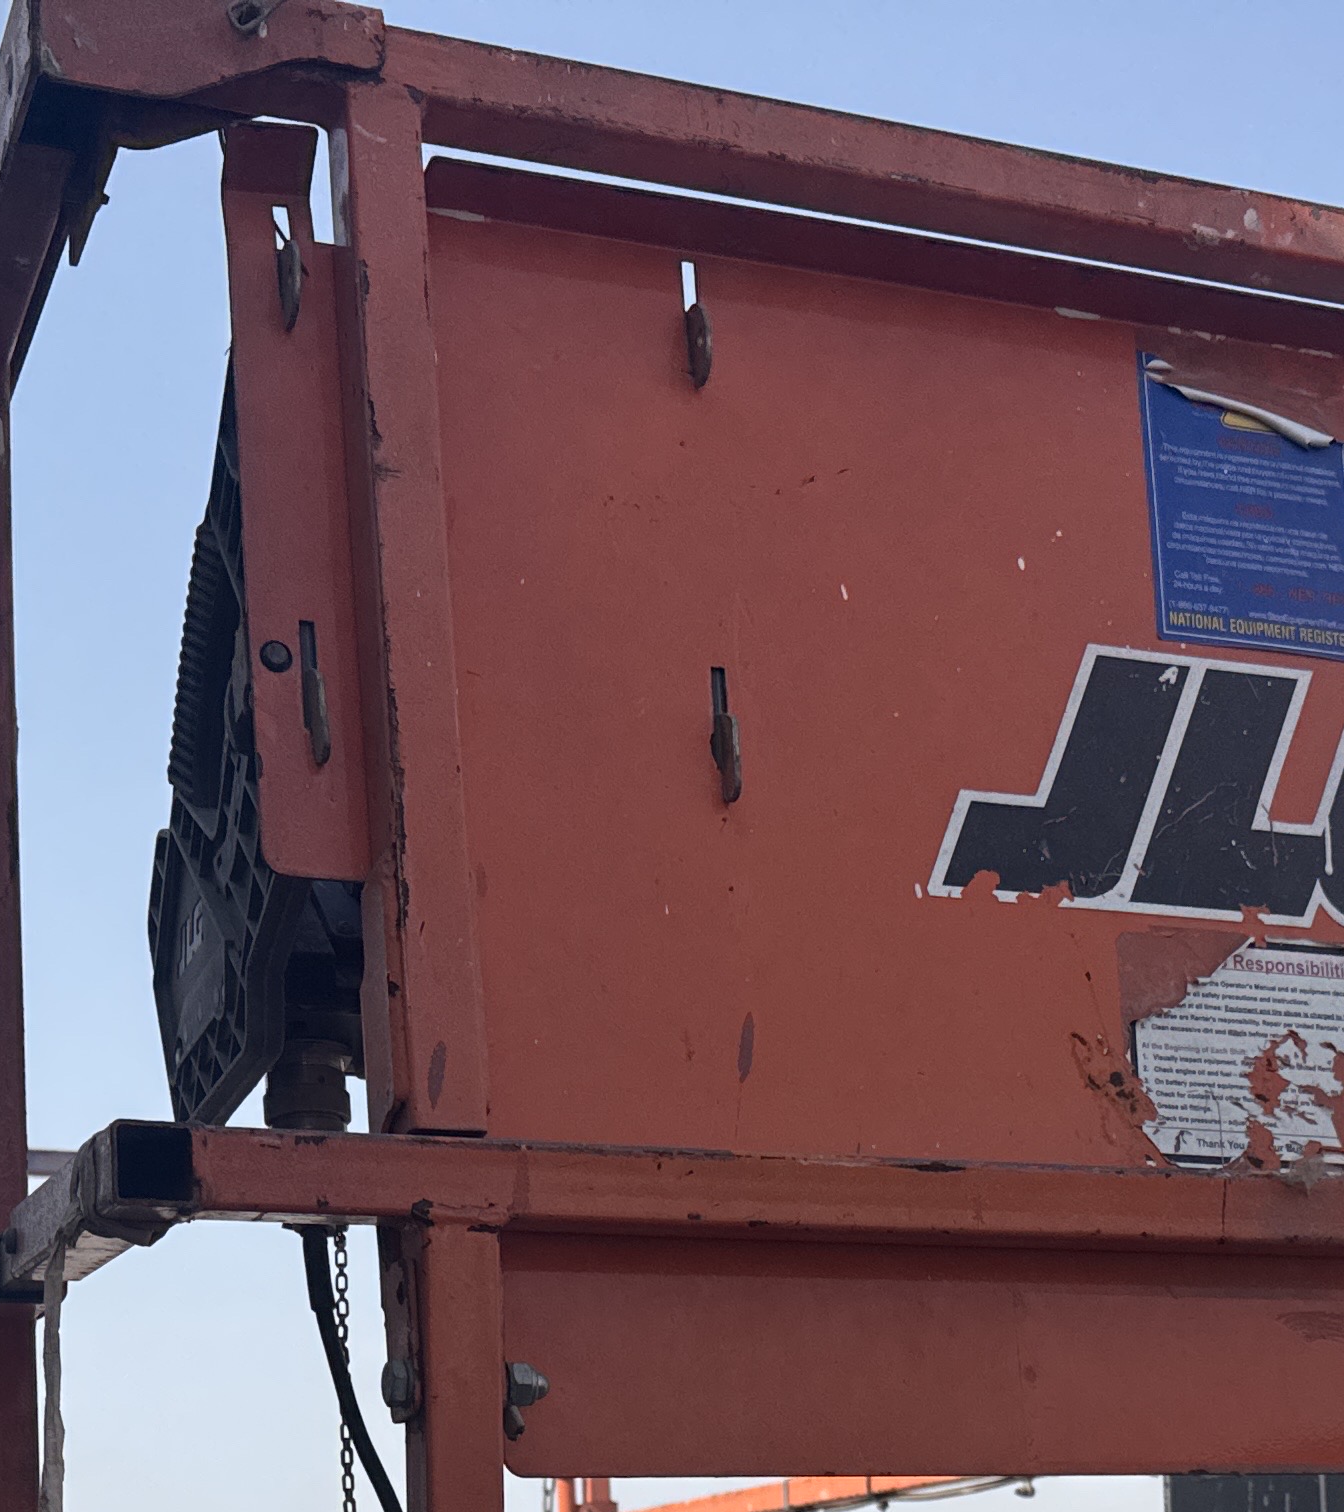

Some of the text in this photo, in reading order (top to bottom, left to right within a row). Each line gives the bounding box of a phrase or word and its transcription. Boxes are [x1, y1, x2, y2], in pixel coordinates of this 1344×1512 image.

[1169, 611, 1226, 632] NATIONAL
[1230, 618, 1296, 641] EQUIPMENT
[1220, 981, 1253, 989] Operator's
[1151, 1023, 1169, 1031] Clean
[1164, 1042, 1200, 1054] Beginning
[1153, 1053, 1178, 1063] Visually
[1179, 1055, 1202, 1064] inspect
[1154, 1065, 1173, 1073] Check
[1175, 1068, 1196, 1076] engine
[1196, 1138, 1225, 1148] Thank
[1227, 1140, 1245, 1149] You
